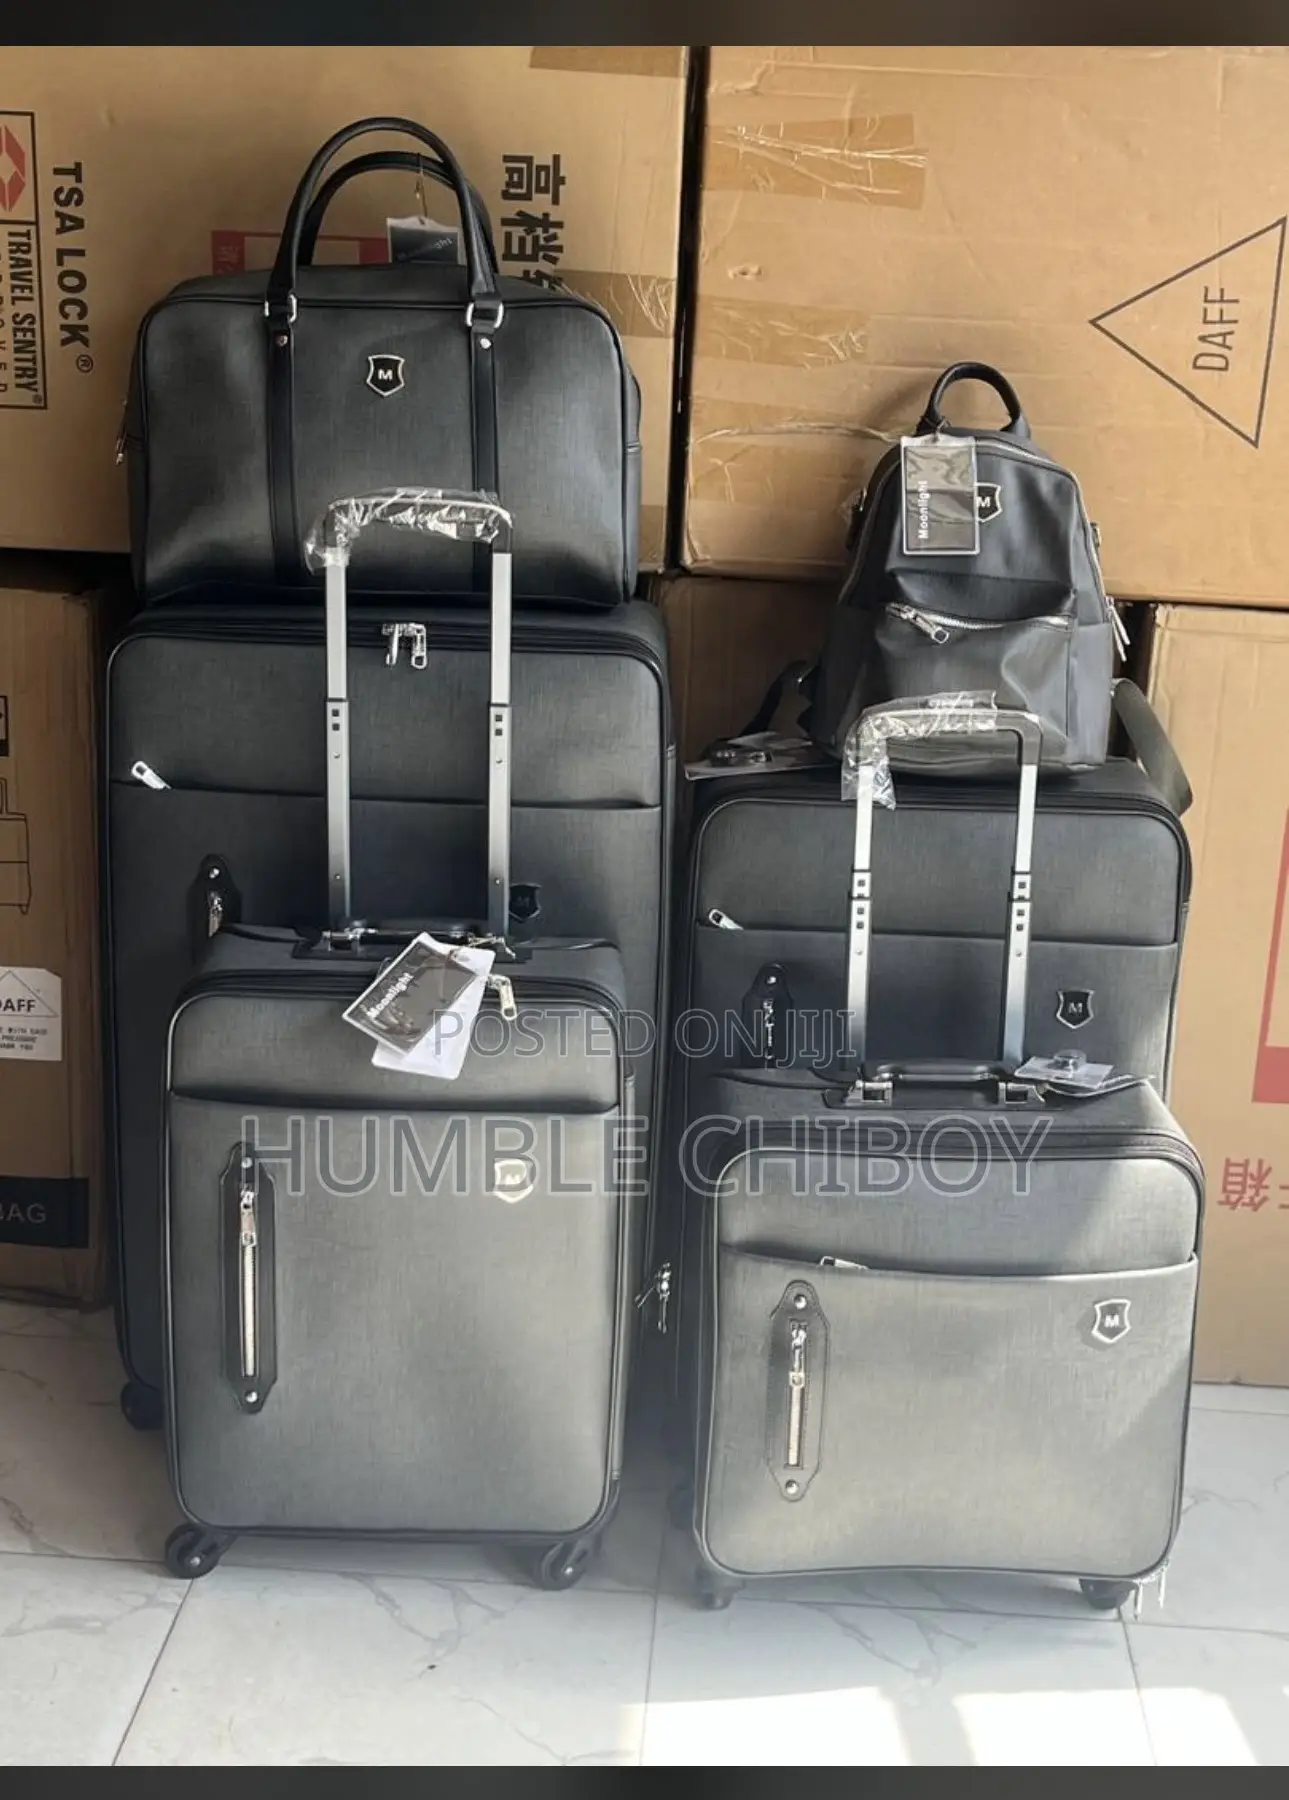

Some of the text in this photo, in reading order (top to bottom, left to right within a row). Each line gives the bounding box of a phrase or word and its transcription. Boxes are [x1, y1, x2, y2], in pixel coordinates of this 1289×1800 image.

[53, 161, 86, 235] TSA
[8, 229, 34, 306] TRAVEL
[1192, 286, 1240, 371] DAFF
[378, 369, 393, 380] M
[917, 480, 931, 539] Moonlight
[975, 496, 991, 508] M
[0, 998, 37, 1013] AFF
[1069, 1002, 1083, 1014] M
[1216, 1157, 1289, 1212] 箱
[1104, 1314, 1120, 1328] M
